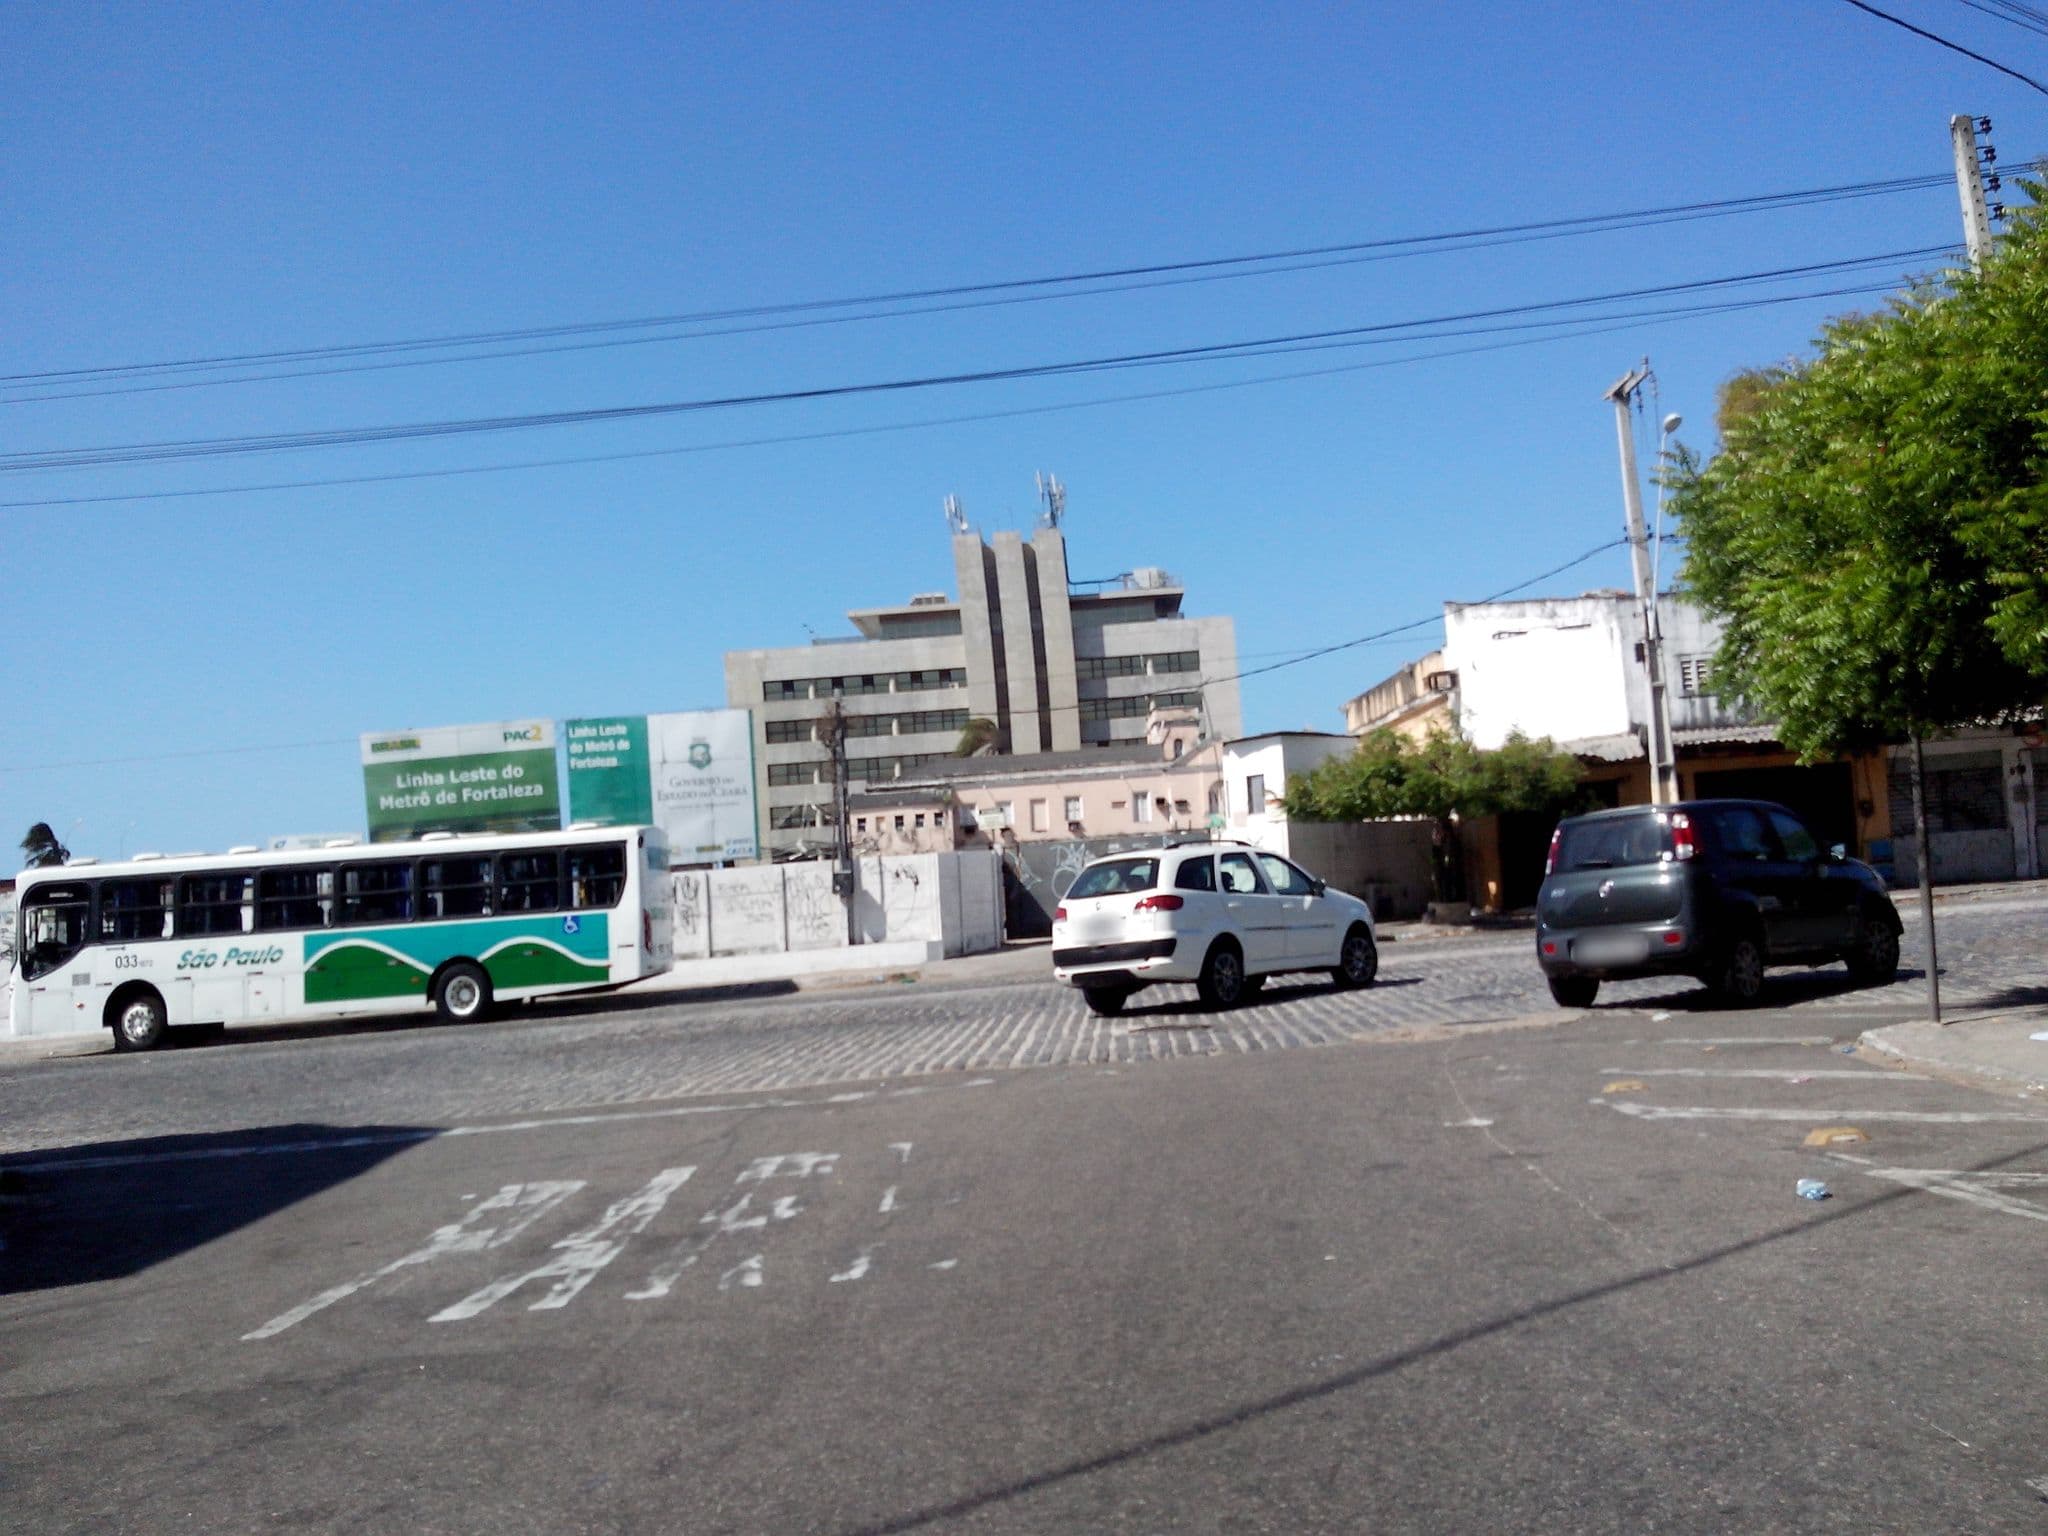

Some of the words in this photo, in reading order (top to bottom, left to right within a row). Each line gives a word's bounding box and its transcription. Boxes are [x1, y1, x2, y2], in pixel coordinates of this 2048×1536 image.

[504, 725, 542, 743] PAC2
[396, 771, 444, 788] Linha
[450, 766, 497, 784] Leste
[502, 764, 524, 778] do
[379, 792, 431, 810] Metrô
[436, 790, 457, 804] de
[462, 783, 543, 802] Fortaleza
[115, 955, 138, 969] 033
[177, 949, 218, 970] São
[223, 945, 284, 967] Paulo
[240, 1142, 960, 1341] PAR
